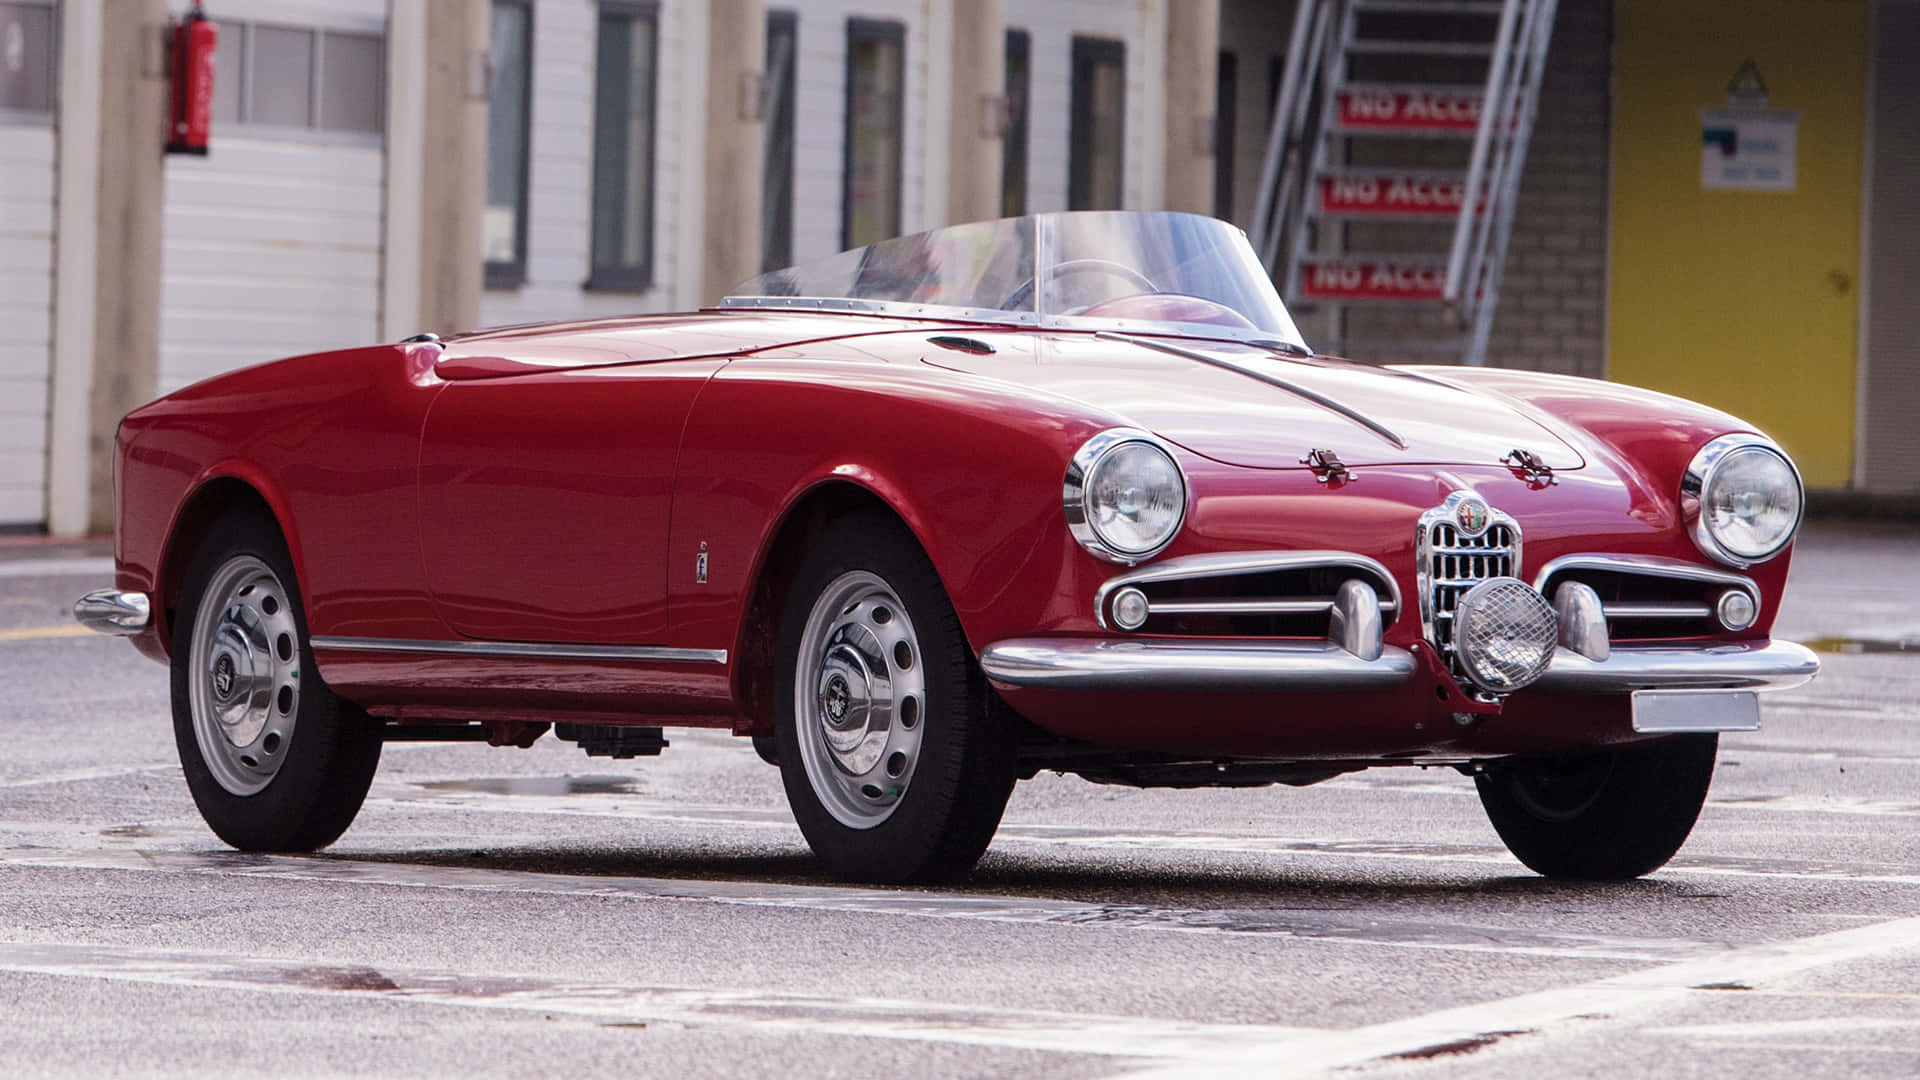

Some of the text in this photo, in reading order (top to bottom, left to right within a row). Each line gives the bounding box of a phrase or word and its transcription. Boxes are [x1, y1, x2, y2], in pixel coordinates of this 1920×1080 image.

[1349, 91, 1500, 121] NO ACCE
[1332, 175, 1483, 206] NO ACCE
[1313, 262, 1465, 291] NO ACCE
